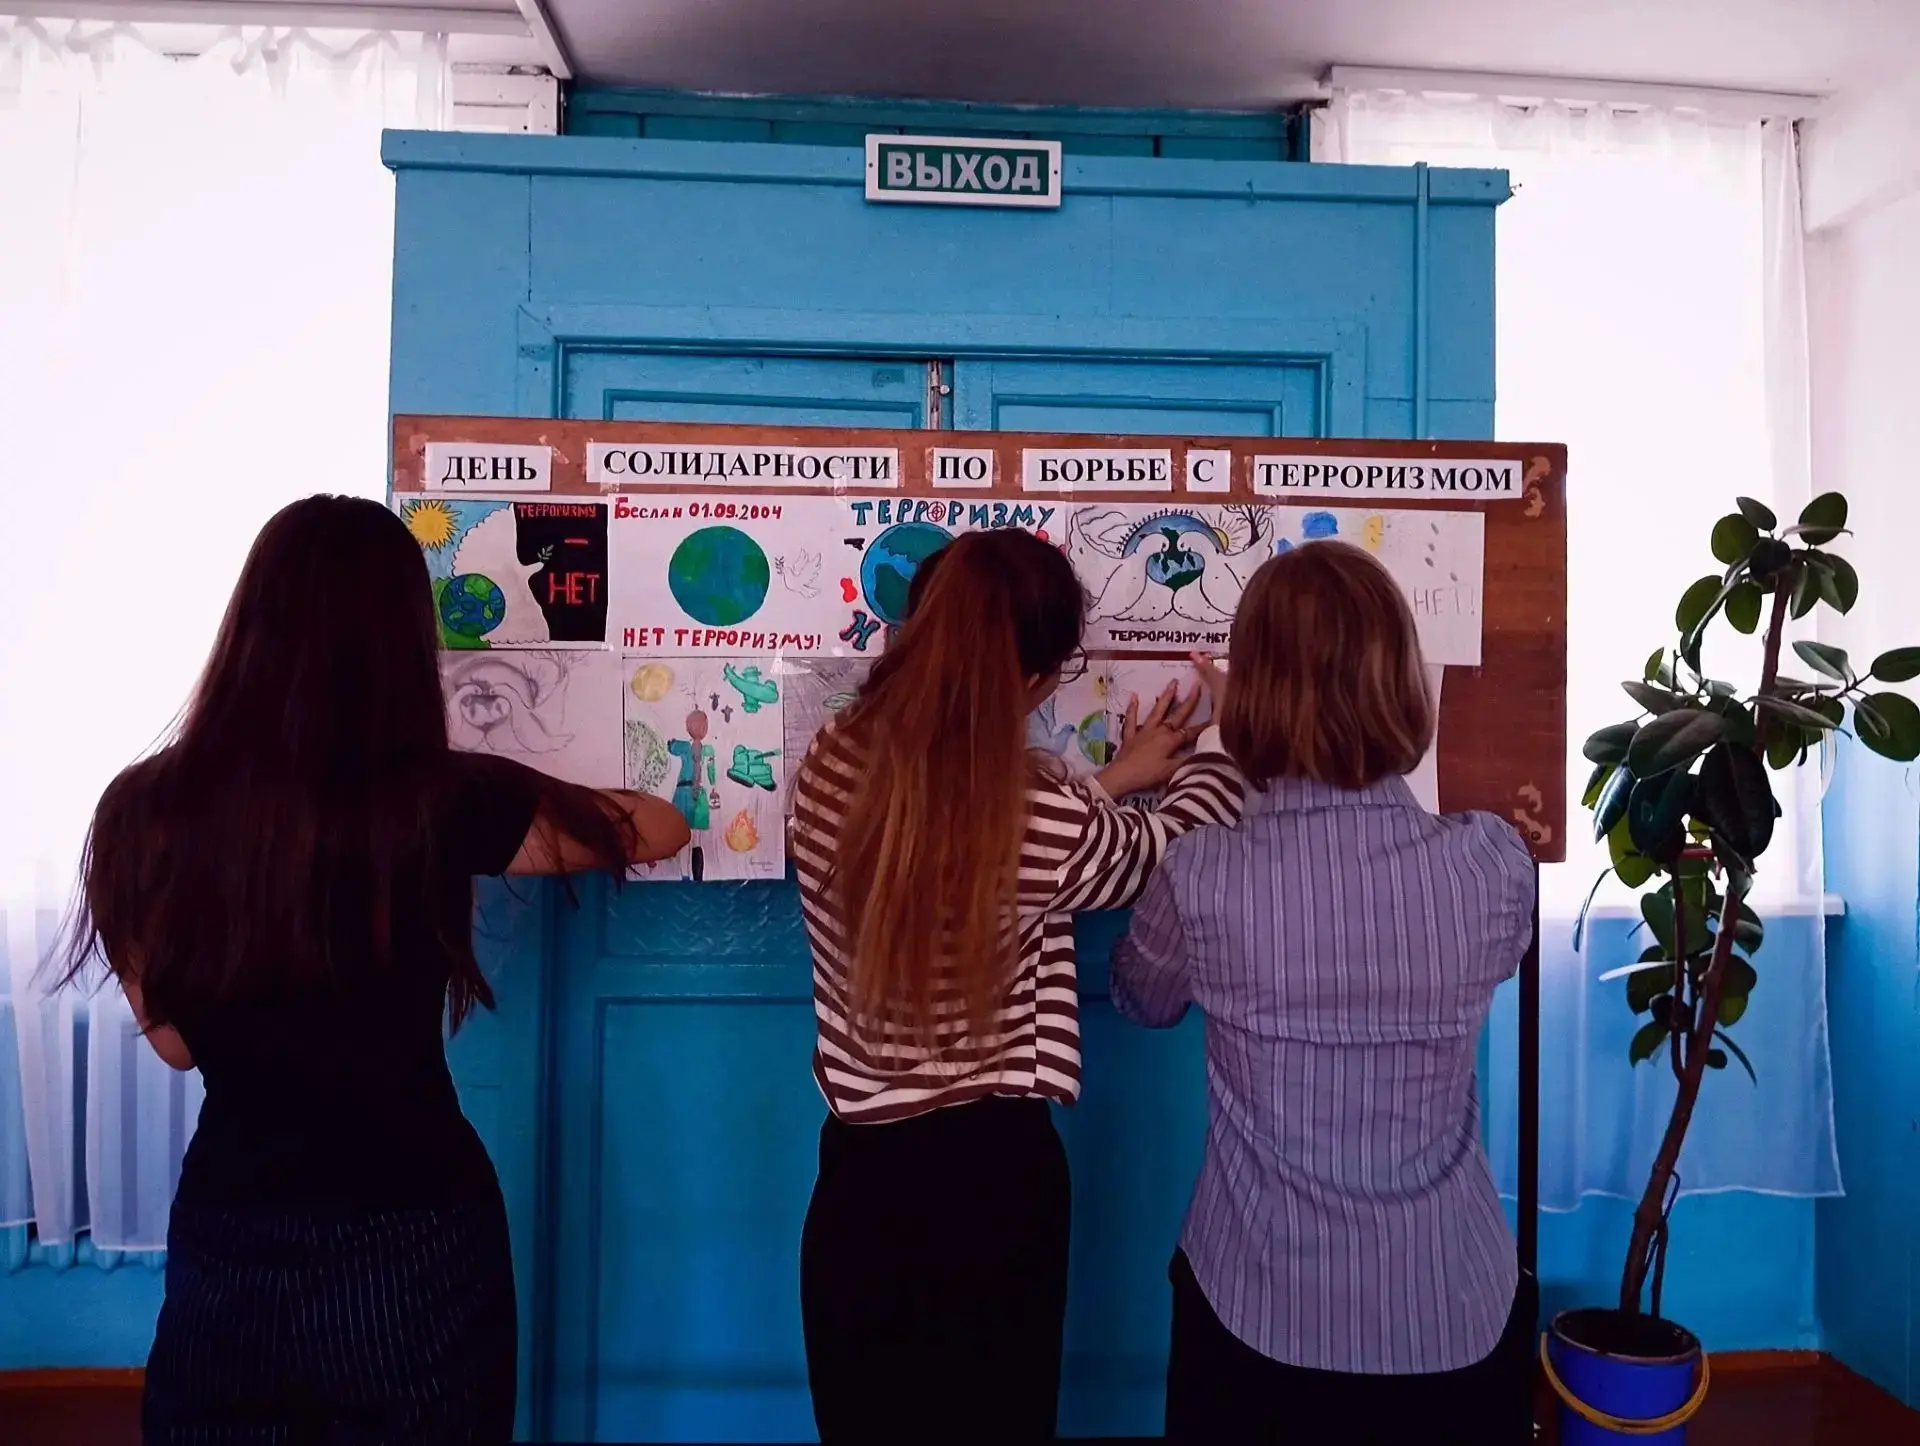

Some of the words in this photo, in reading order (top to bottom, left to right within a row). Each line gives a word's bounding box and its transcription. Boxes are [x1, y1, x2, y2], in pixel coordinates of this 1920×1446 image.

[887, 151, 1041, 191] ВЫХОД
[441, 455, 537, 484] ДЕНЬ
[603, 449, 891, 480] СОЛИДАРНОСТИ
[938, 455, 987, 480] ПО
[1039, 458, 1168, 482] БОРЬБЕ
[1192, 459, 1215, 482] С
[1258, 463, 1513, 490] ТЕРРОРИЗМОМ
[517, 503, 597, 518] ТЕРРОРИЗМУ
[614, 497, 682, 519] Беслан
[689, 502, 782, 520] 01.09.2004
[851, 499, 1056, 529] ТЕРРОРИЗМУ
[548, 572, 600, 604] НЕТ
[623, 628, 665, 647] НЕТ
[674, 629, 822, 650] ТЕРРОРИЗМУ!
